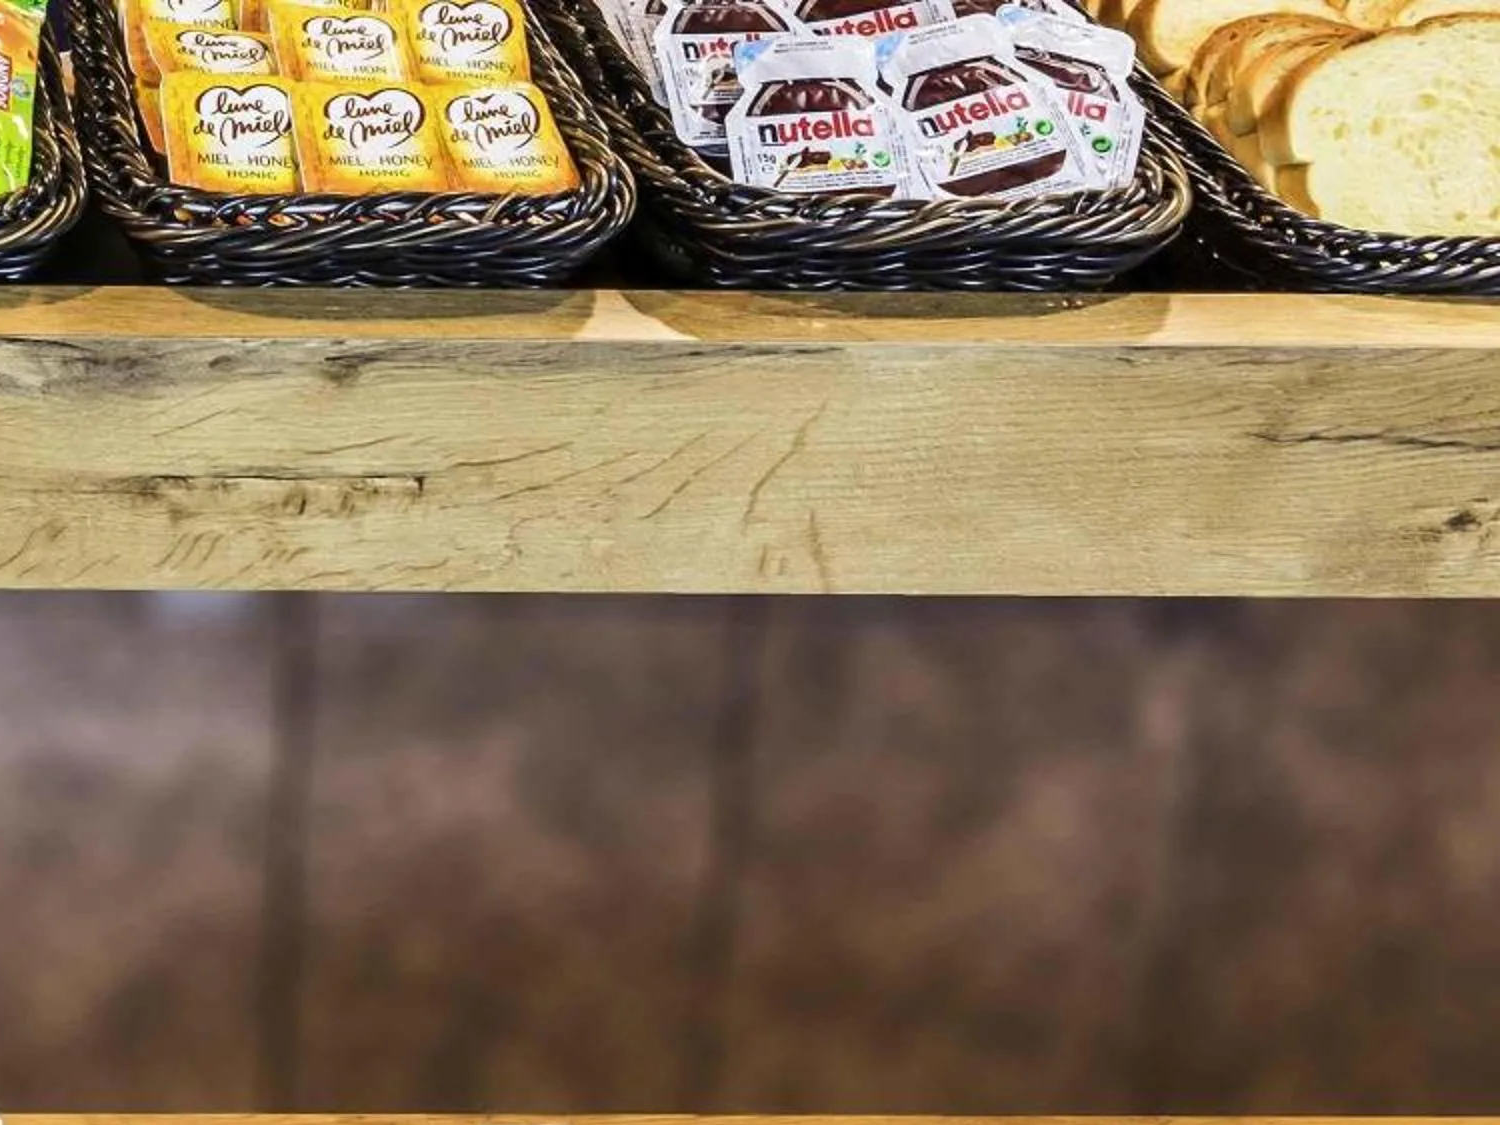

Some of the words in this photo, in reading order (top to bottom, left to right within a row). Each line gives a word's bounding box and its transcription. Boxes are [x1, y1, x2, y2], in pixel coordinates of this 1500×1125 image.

[212, 91, 268, 115] lune
[340, 98, 400, 119] lune
[461, 100, 518, 123] lune
[917, 89, 1031, 138] nutella
[193, 119, 216, 136] de
[220, 109, 285, 147] miel
[323, 123, 347, 140] de
[350, 111, 414, 149] miel
[450, 128, 474, 143] de
[475, 111, 534, 152] miel
[758, 111, 876, 144] nutella
